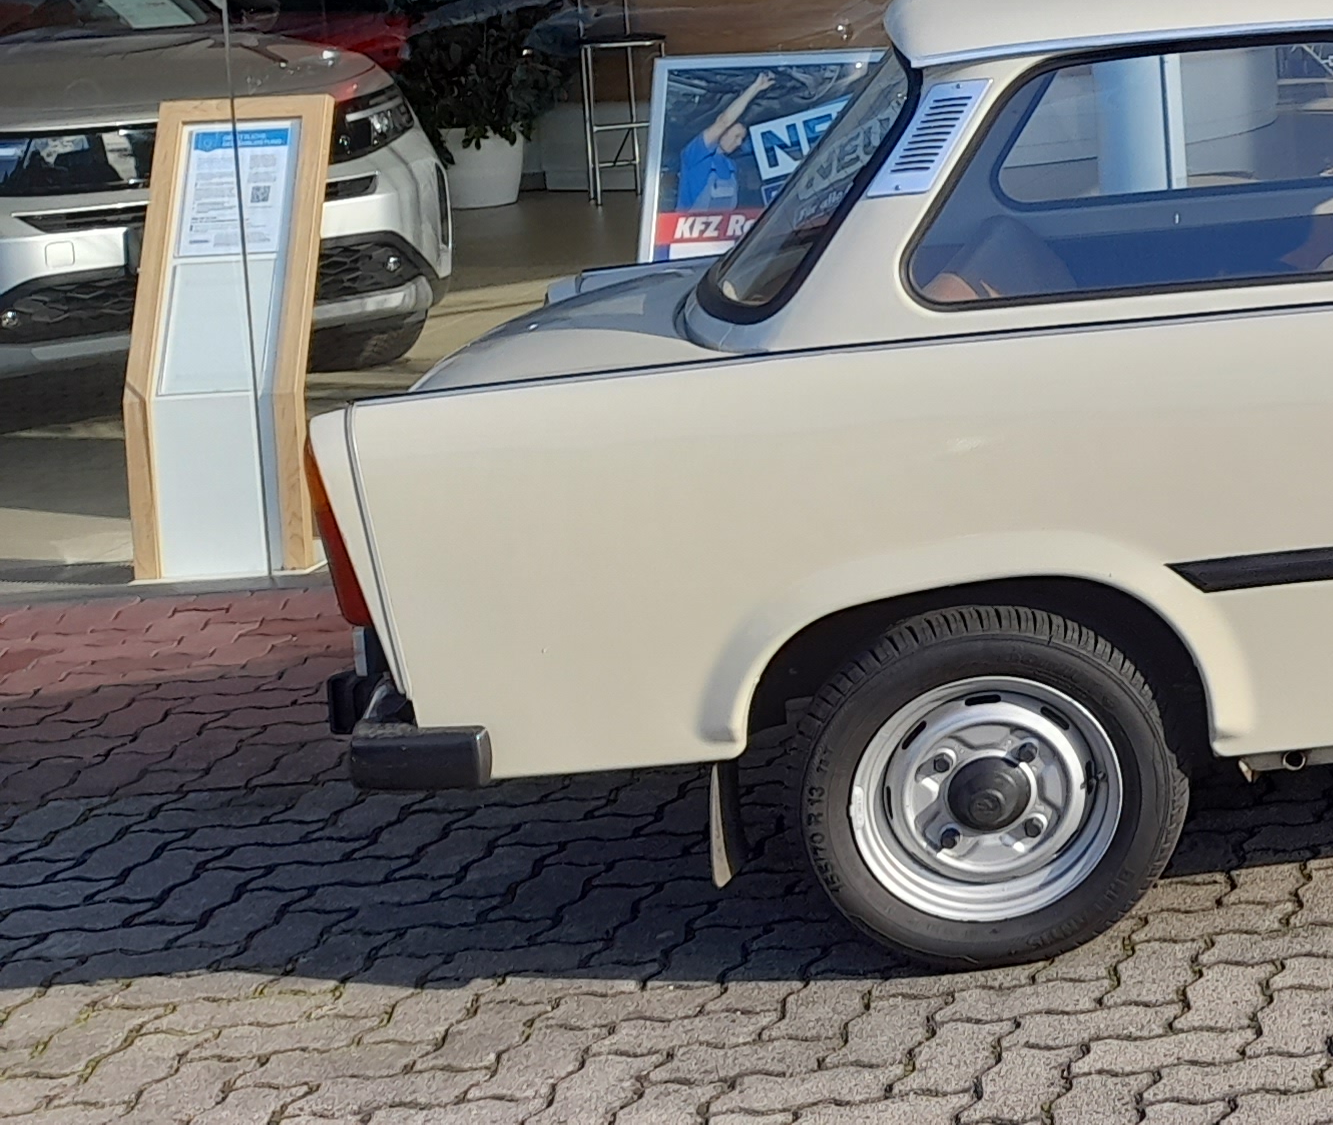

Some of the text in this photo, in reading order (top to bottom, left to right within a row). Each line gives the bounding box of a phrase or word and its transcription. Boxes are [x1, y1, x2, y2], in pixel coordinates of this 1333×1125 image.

[674, 216, 723, 240] KFZ
[806, 785, 824, 805] 13
[805, 812, 824, 826] R
[807, 830, 846, 896] 155/70
